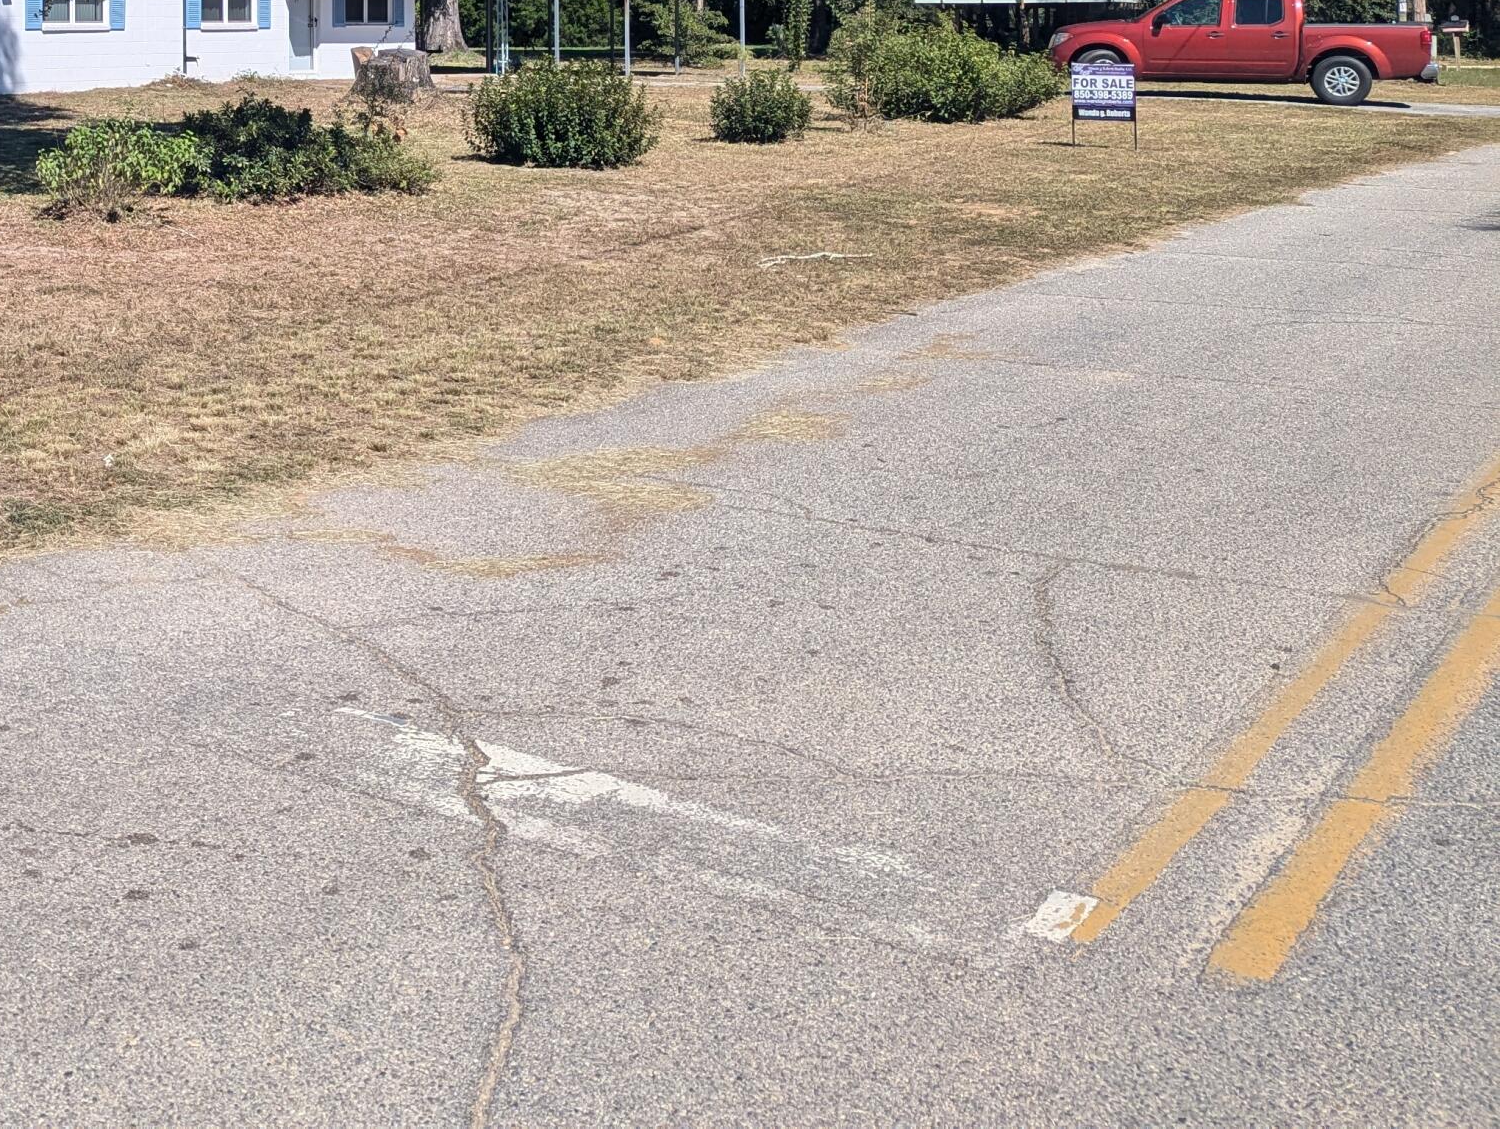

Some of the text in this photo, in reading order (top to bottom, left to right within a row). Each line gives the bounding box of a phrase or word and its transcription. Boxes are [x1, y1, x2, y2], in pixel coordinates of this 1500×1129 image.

[1073, 78, 1133, 89] FOR SALE
[1074, 90, 1133, 100] 850-398-5389
